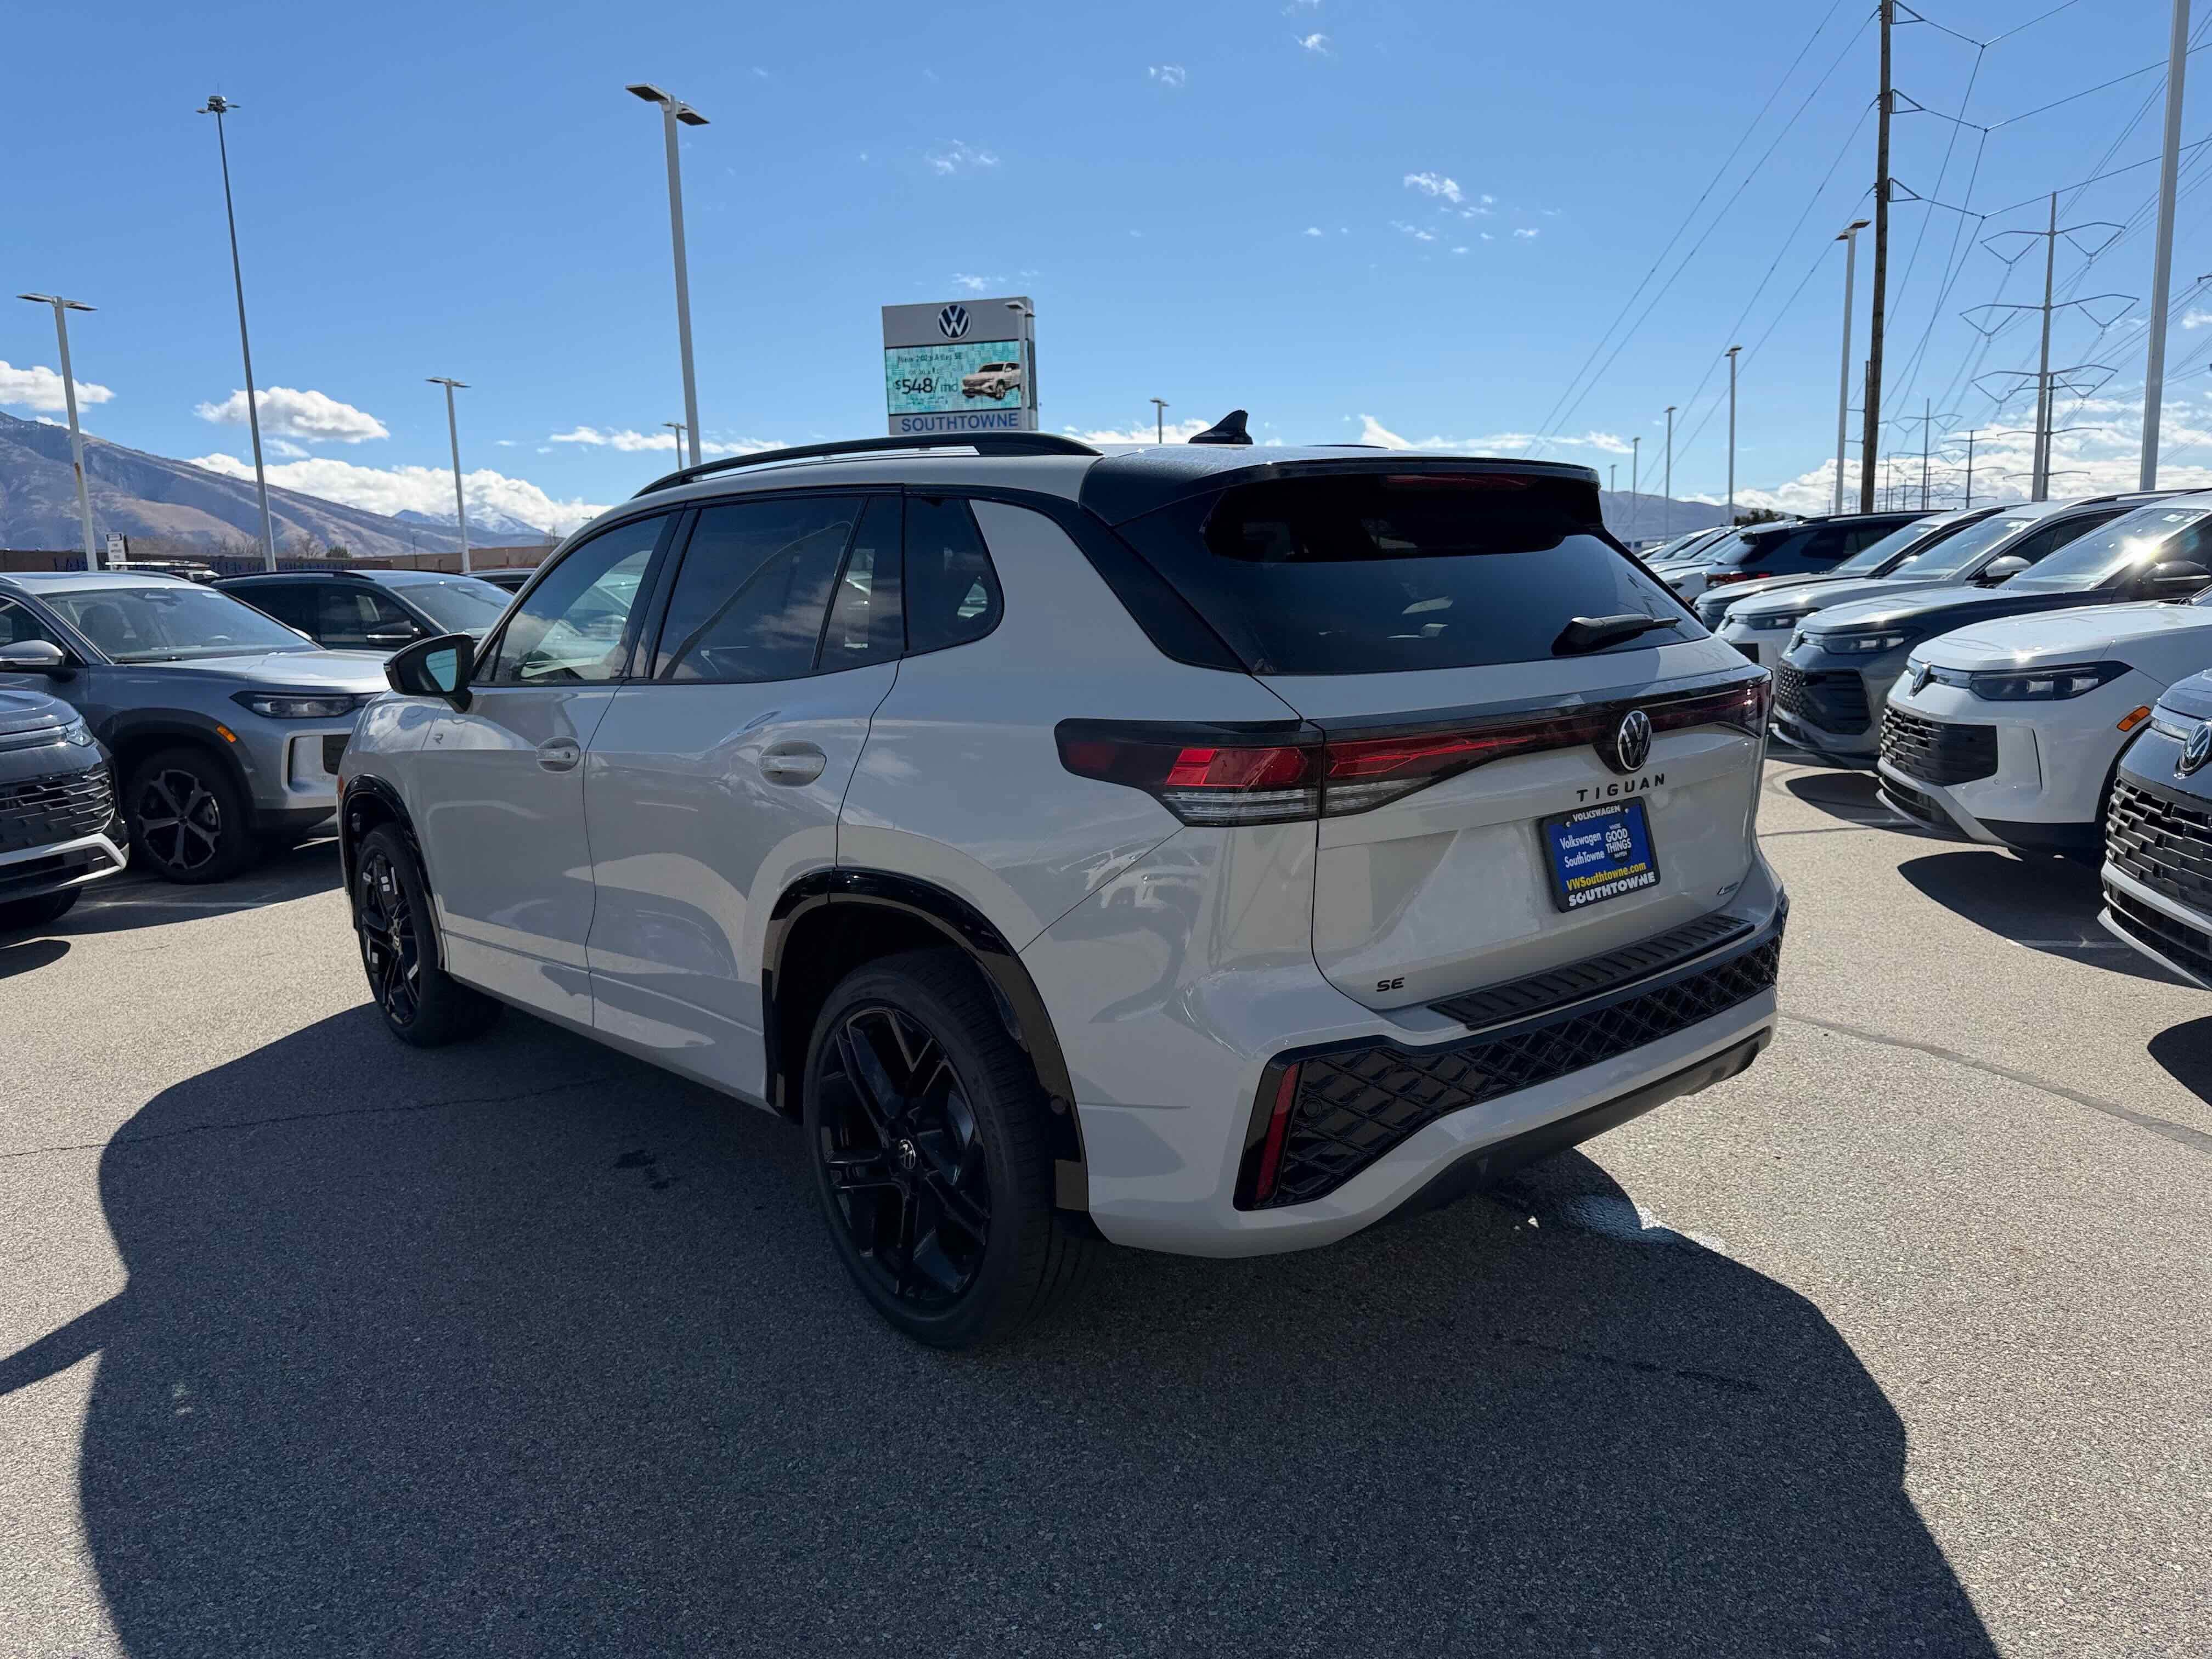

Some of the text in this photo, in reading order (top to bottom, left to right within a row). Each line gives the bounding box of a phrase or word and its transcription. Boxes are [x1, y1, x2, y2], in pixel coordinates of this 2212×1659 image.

[901, 412, 1019, 432] SOUTHTOWNE
[1576, 773, 1665, 802] TIGUAN
[1572, 805, 1621, 822] VOLKSWAGEN
[1559, 832, 1602, 850] Volkswagen
[1605, 828, 1628, 843] GOOD
[1605, 838, 1632, 854] THINGS
[1564, 850, 1605, 868] SouthTowne
[1566, 862, 1647, 891] VWSouthtowne.com
[1568, 871, 1656, 907] SOUTHTOWNE
[1376, 977, 1405, 992] SE
